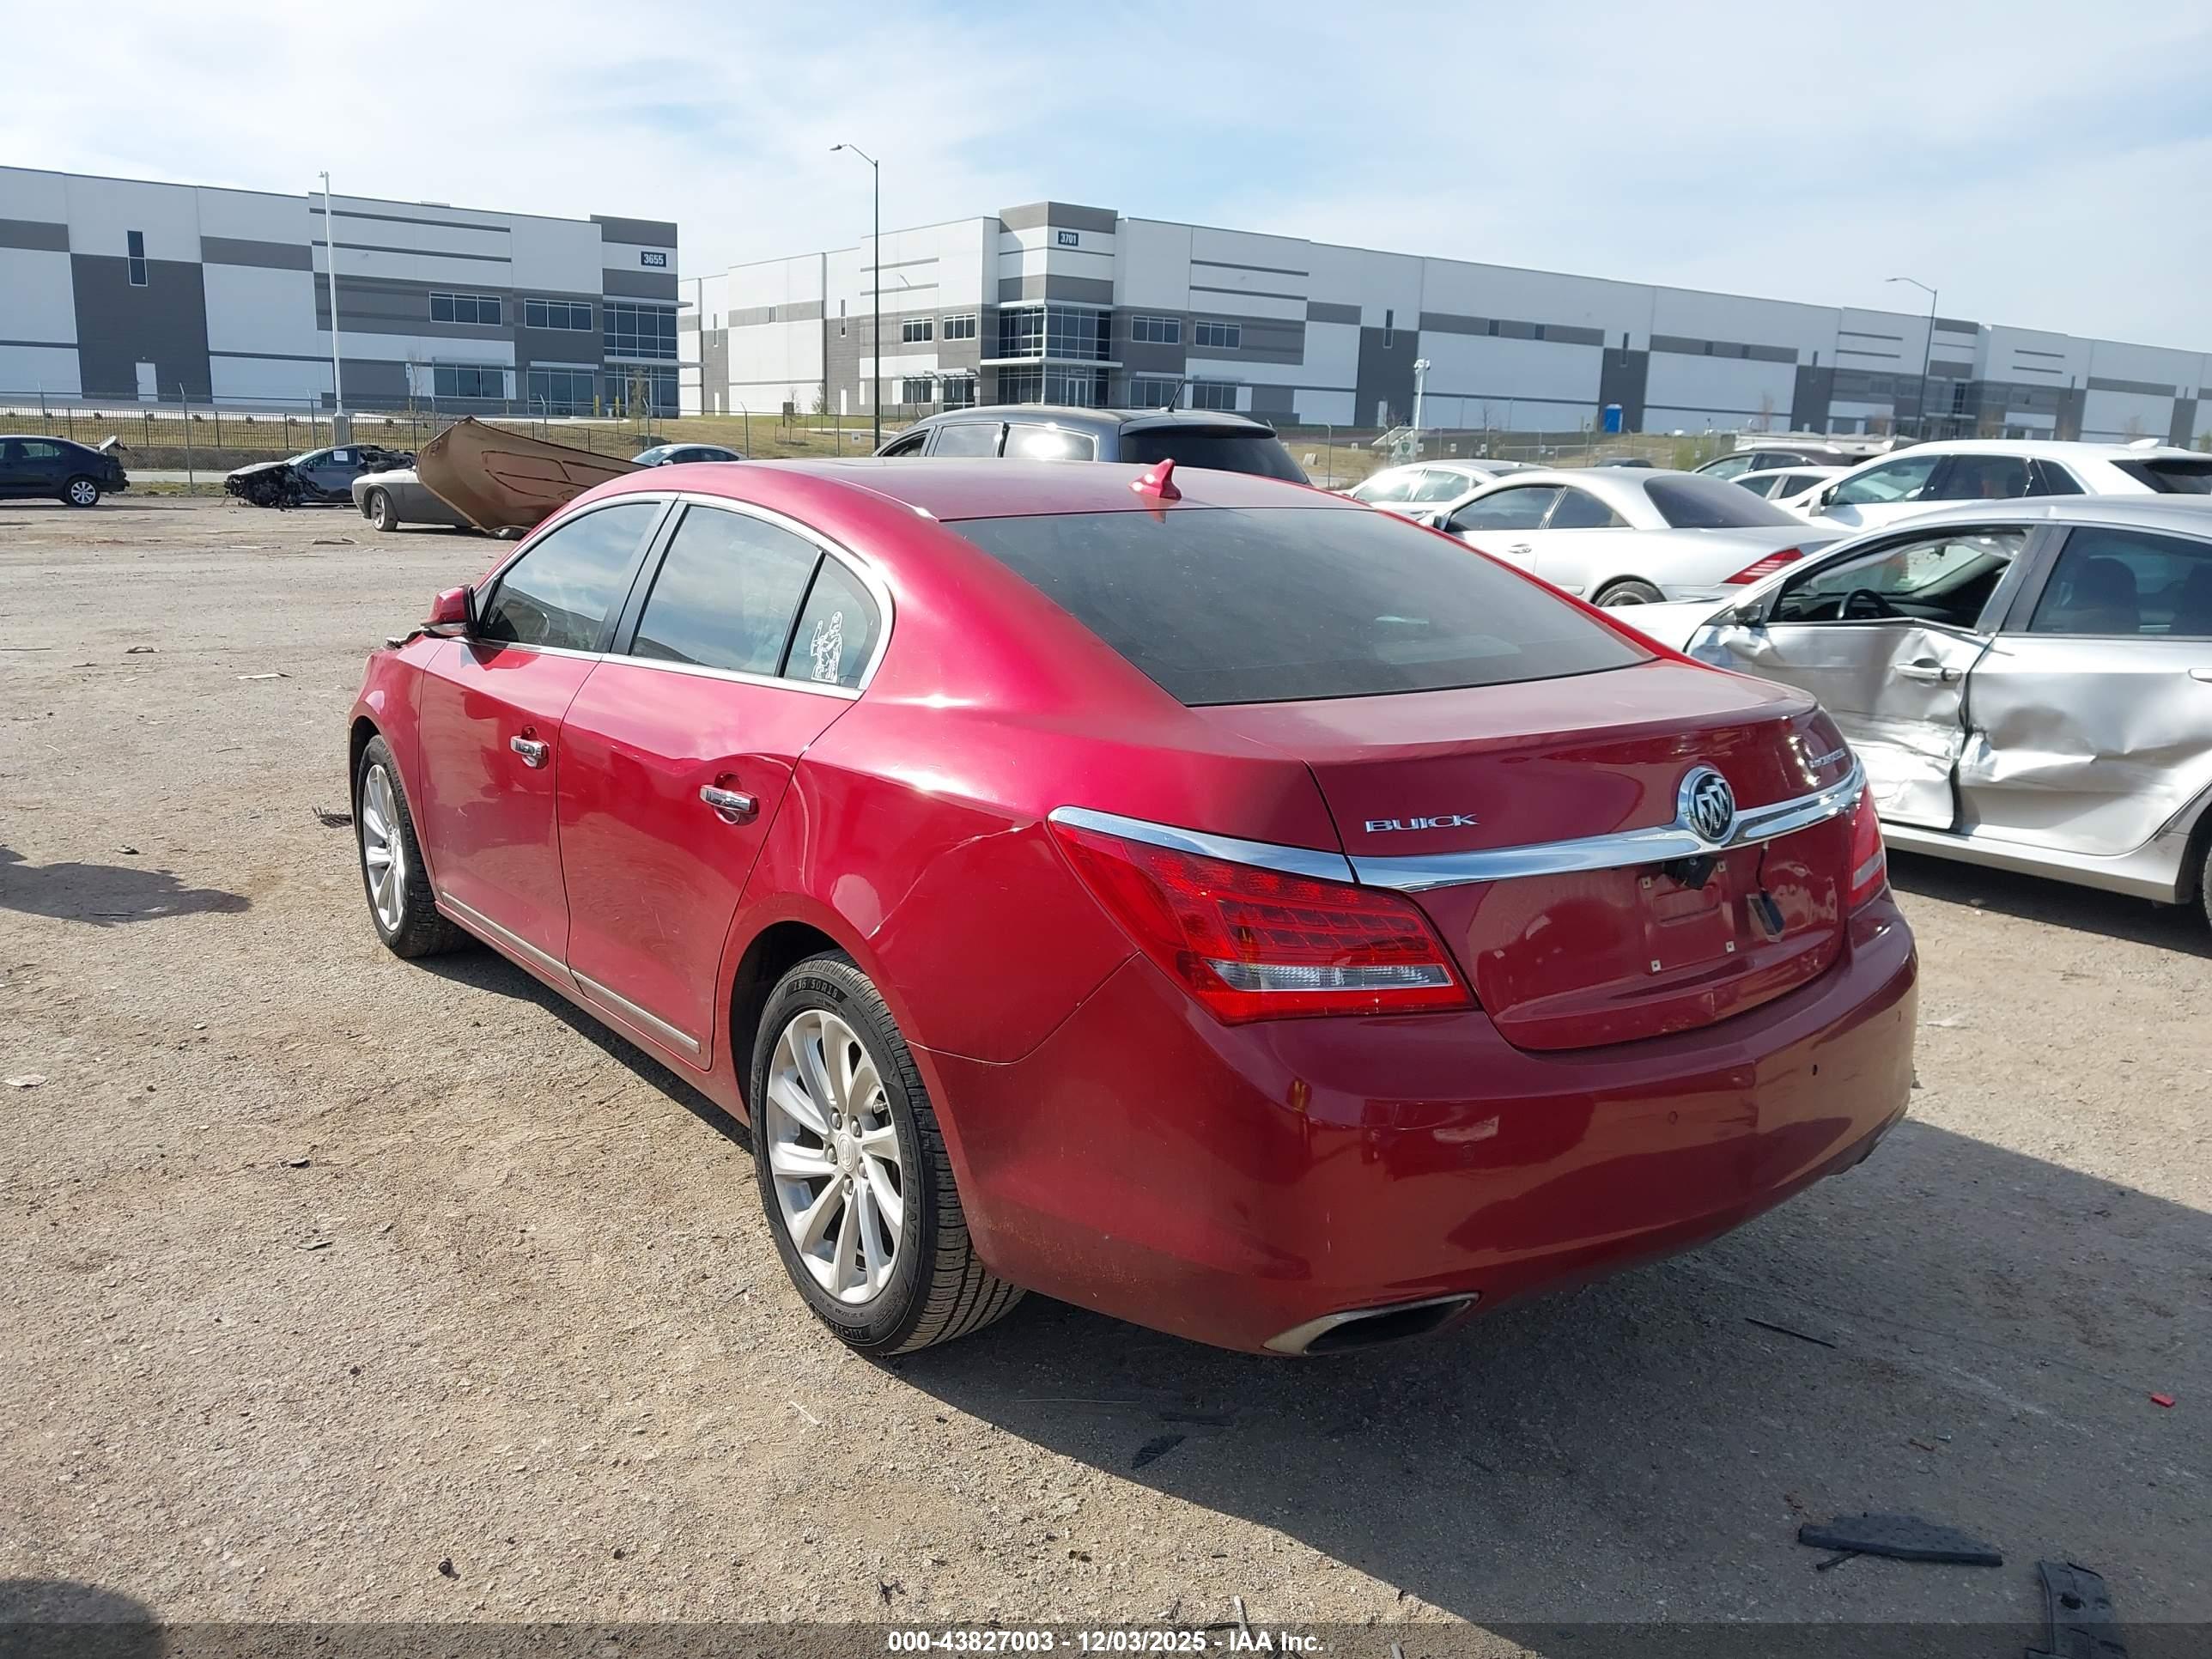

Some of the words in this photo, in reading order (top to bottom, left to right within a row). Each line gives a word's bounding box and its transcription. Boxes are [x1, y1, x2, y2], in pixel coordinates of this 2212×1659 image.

[1060, 233, 1077, 244] 3701
[644, 253, 664, 265] 3655
[1365, 814, 1480, 833] BUICK
